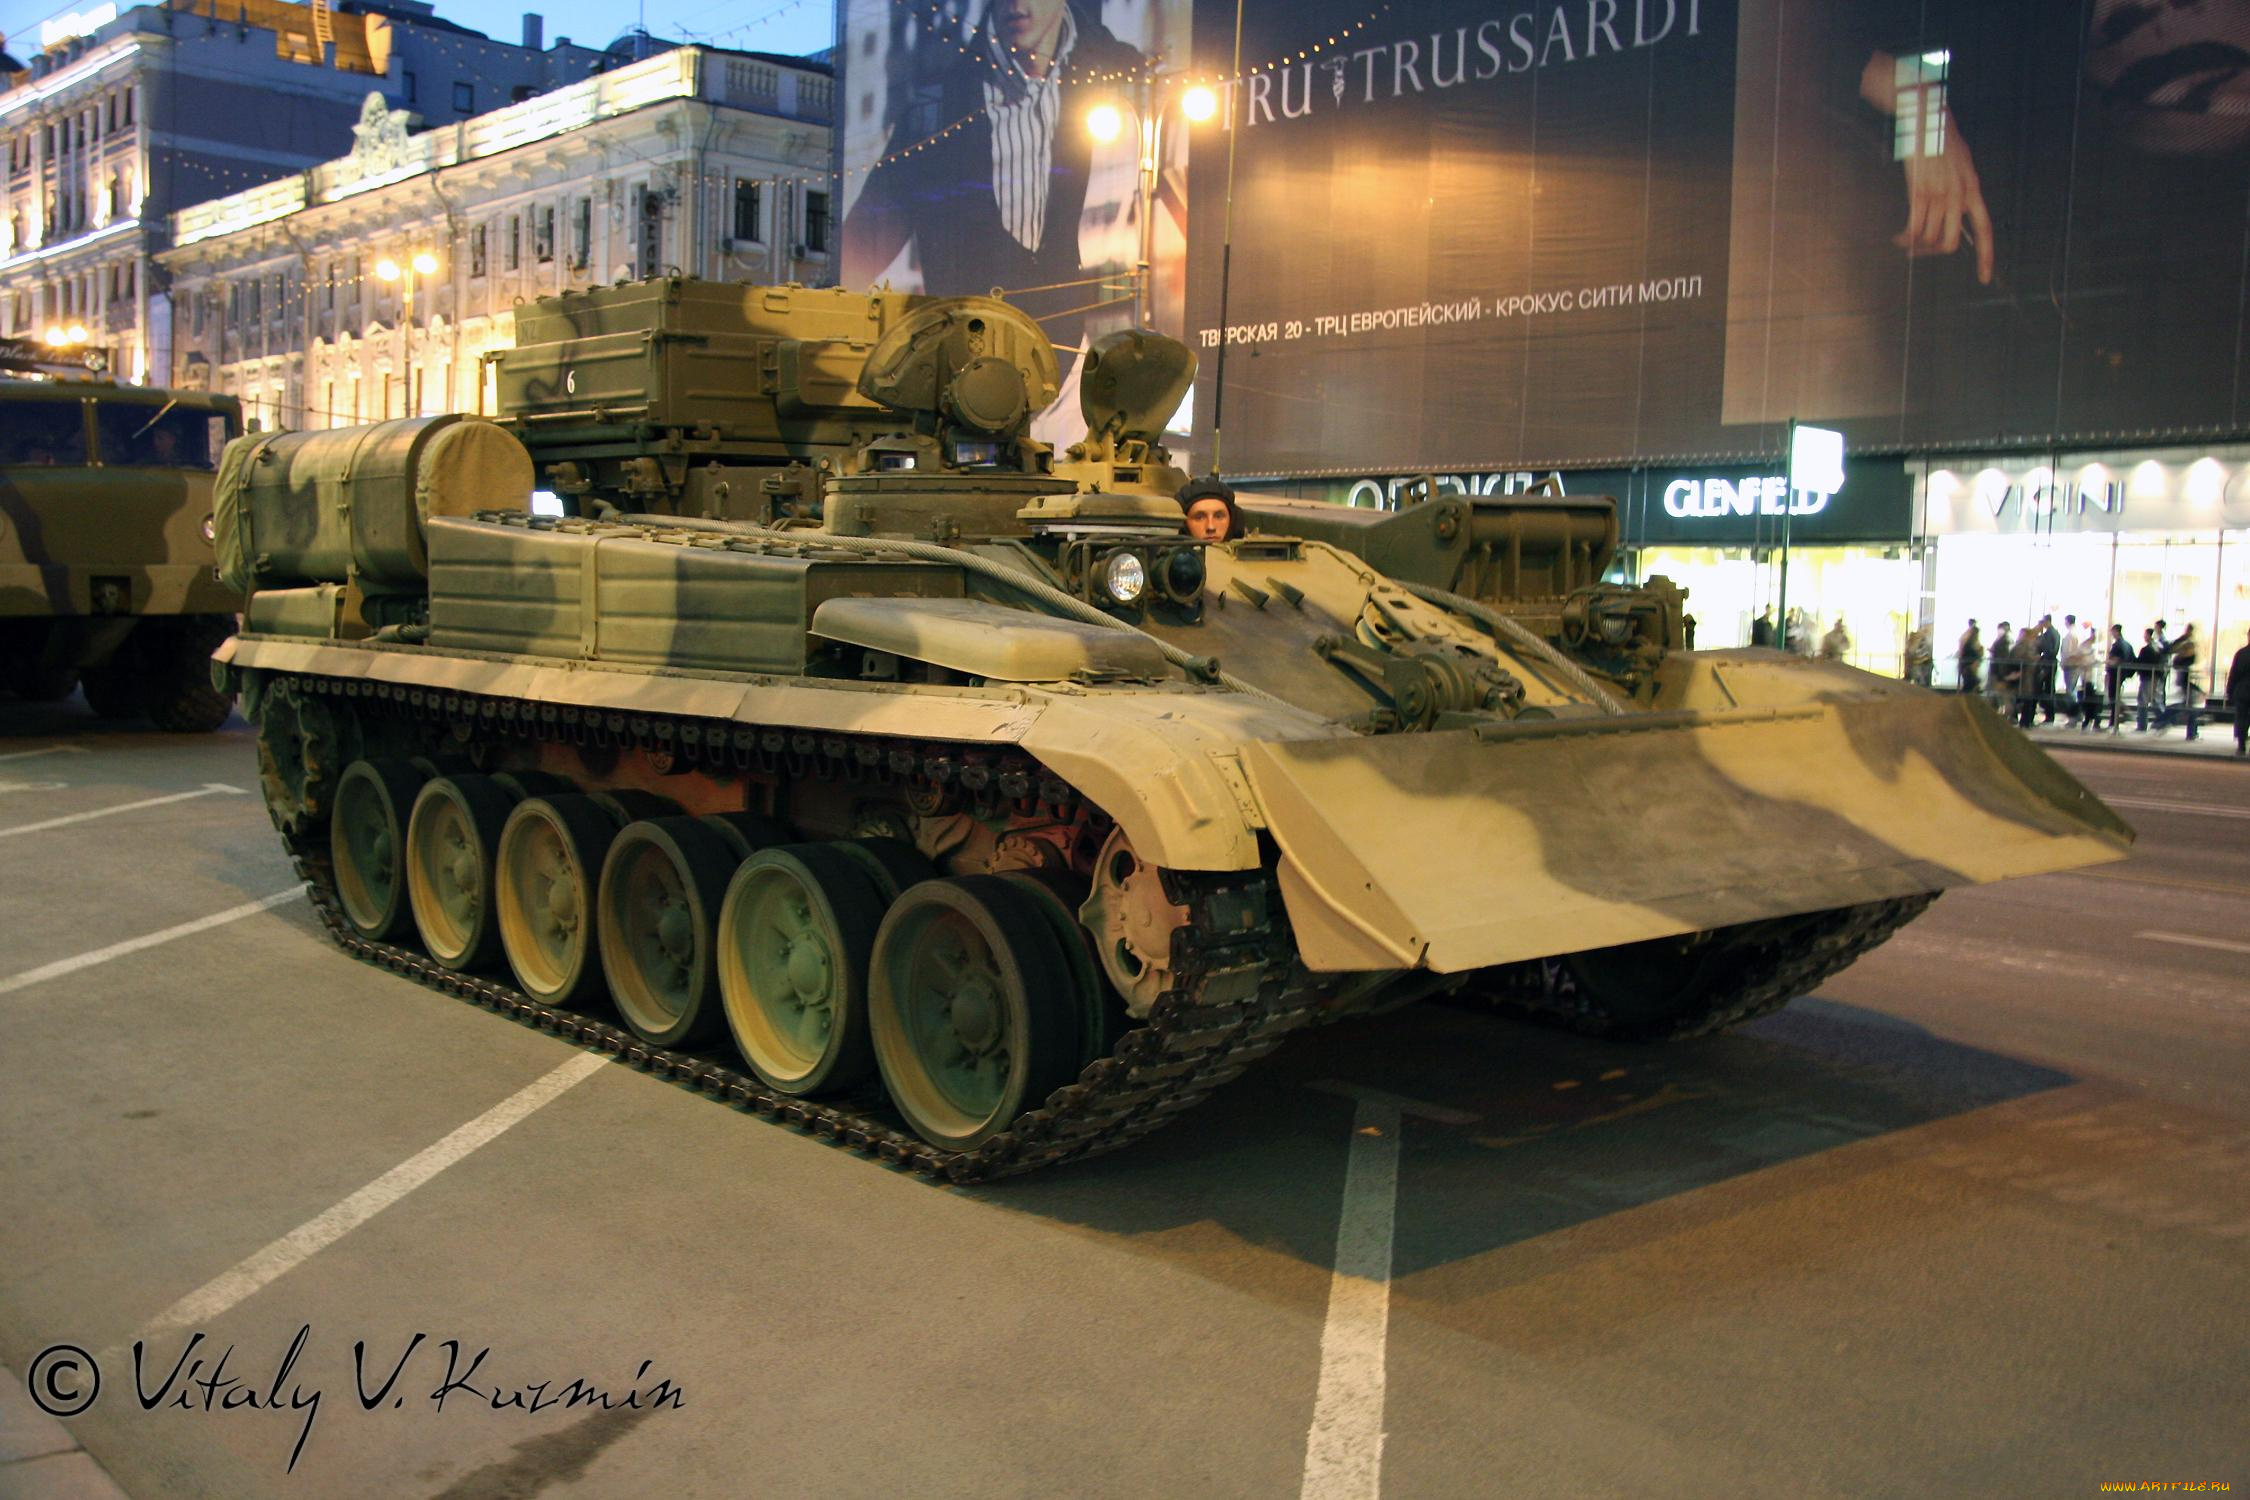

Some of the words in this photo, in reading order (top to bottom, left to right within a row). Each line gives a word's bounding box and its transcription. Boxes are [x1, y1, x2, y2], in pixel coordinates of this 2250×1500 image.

[1353, 0, 1700, 102] TRUSSARDI
[1200, 323, 1278, 347] ТВЕРСКАЯ
[1284, 321, 1303, 340] 20
[1315, 314, 1347, 337] ТРЦ
[1351, 297, 1480, 332] ЕВРОПЕЙСКИЙ
[1496, 290, 1573, 318] КРОКУС
[1578, 284, 1633, 309] СИТИ
[1638, 276, 1702, 303] МОЛЛ
[567, 370, 575, 394] 6
[1664, 476, 1828, 518] GLENFIELD
[1986, 479, 2125, 517] VICINI
